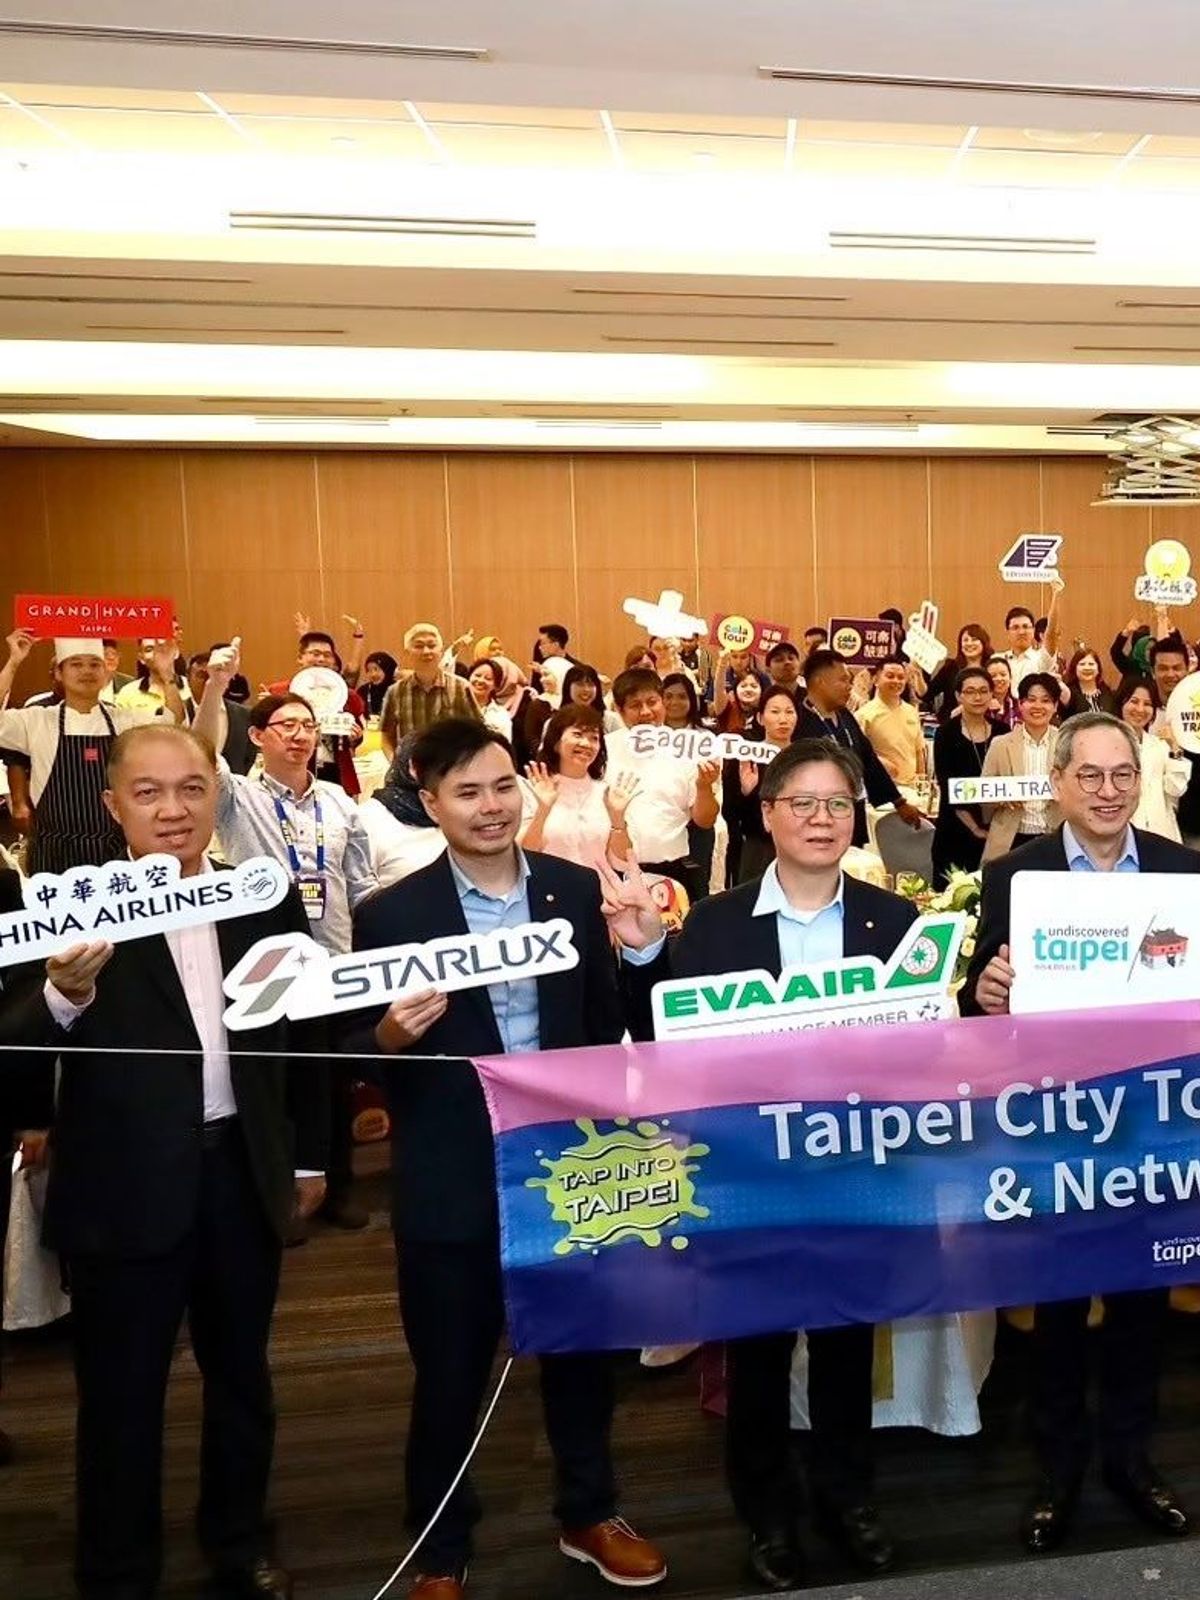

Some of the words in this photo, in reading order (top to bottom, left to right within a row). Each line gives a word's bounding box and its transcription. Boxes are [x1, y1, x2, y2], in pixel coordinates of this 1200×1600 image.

[28, 605, 92, 617] GRAND
[103, 607, 162, 619] HYATT
[631, 730, 713, 760] Eagle
[981, 783, 1012, 798] F.H.
[1018, 780, 1052, 797] TRA
[37, 865, 169, 909] 中華航空
[0, 913, 85, 948] HINA
[93, 882, 233, 928] AIRLINES
[1048, 925, 1129, 938] undiscovered
[331, 930, 567, 999] STARLUX
[1032, 928, 1129, 971] taipei
[759, 1082, 974, 1165] Taipei
[995, 1076, 1127, 1143] City
[559, 1166, 611, 1191] TAP
[616, 1157, 675, 1180] INTO
[983, 1167, 1033, 1222] &
[566, 1178, 679, 1224] TAIPEI
